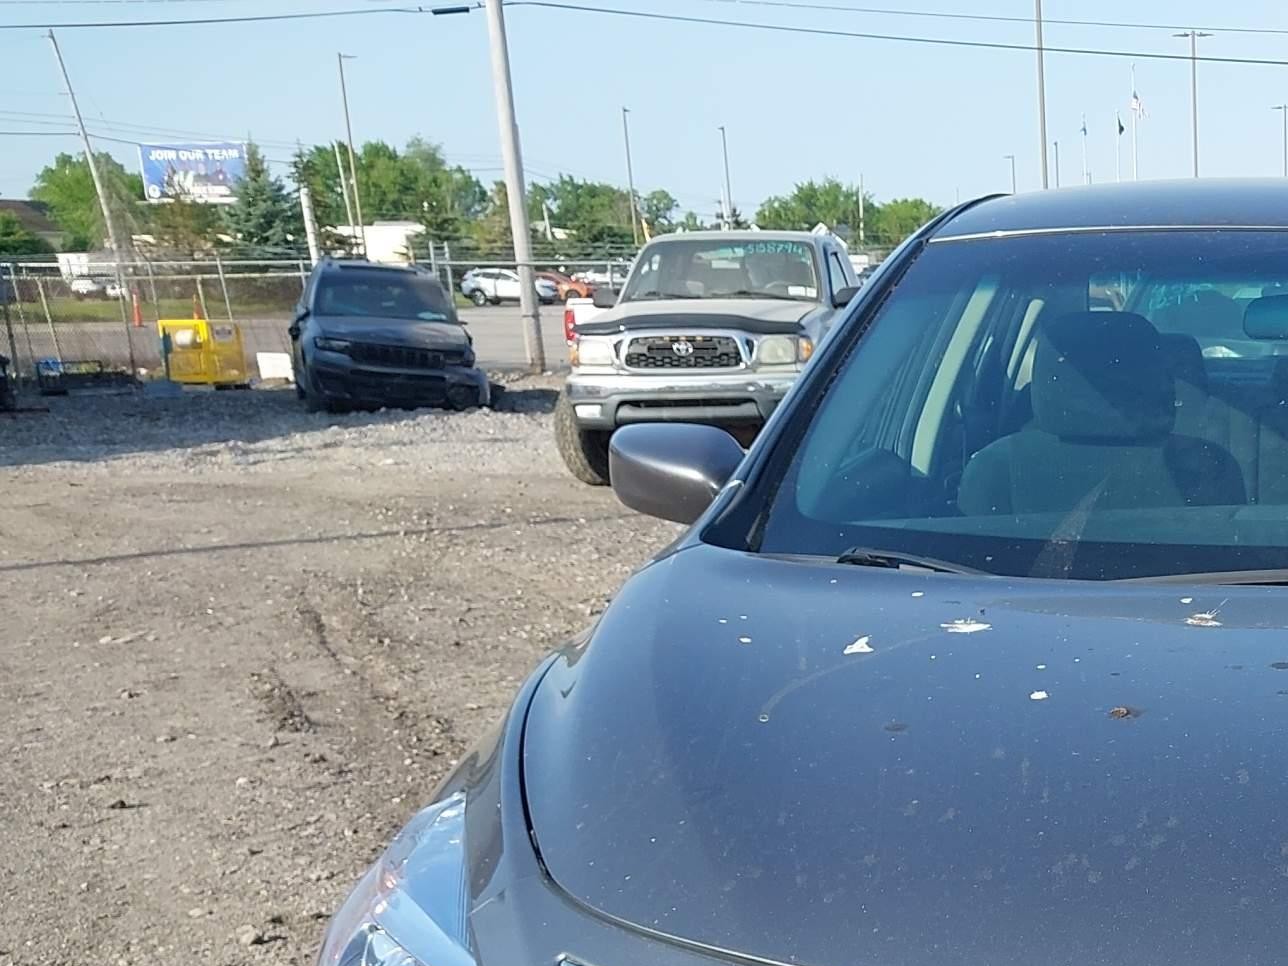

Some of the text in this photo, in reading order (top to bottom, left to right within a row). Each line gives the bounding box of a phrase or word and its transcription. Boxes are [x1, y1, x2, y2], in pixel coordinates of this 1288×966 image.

[149, 149, 240, 161] JOIN OUR TEAM
